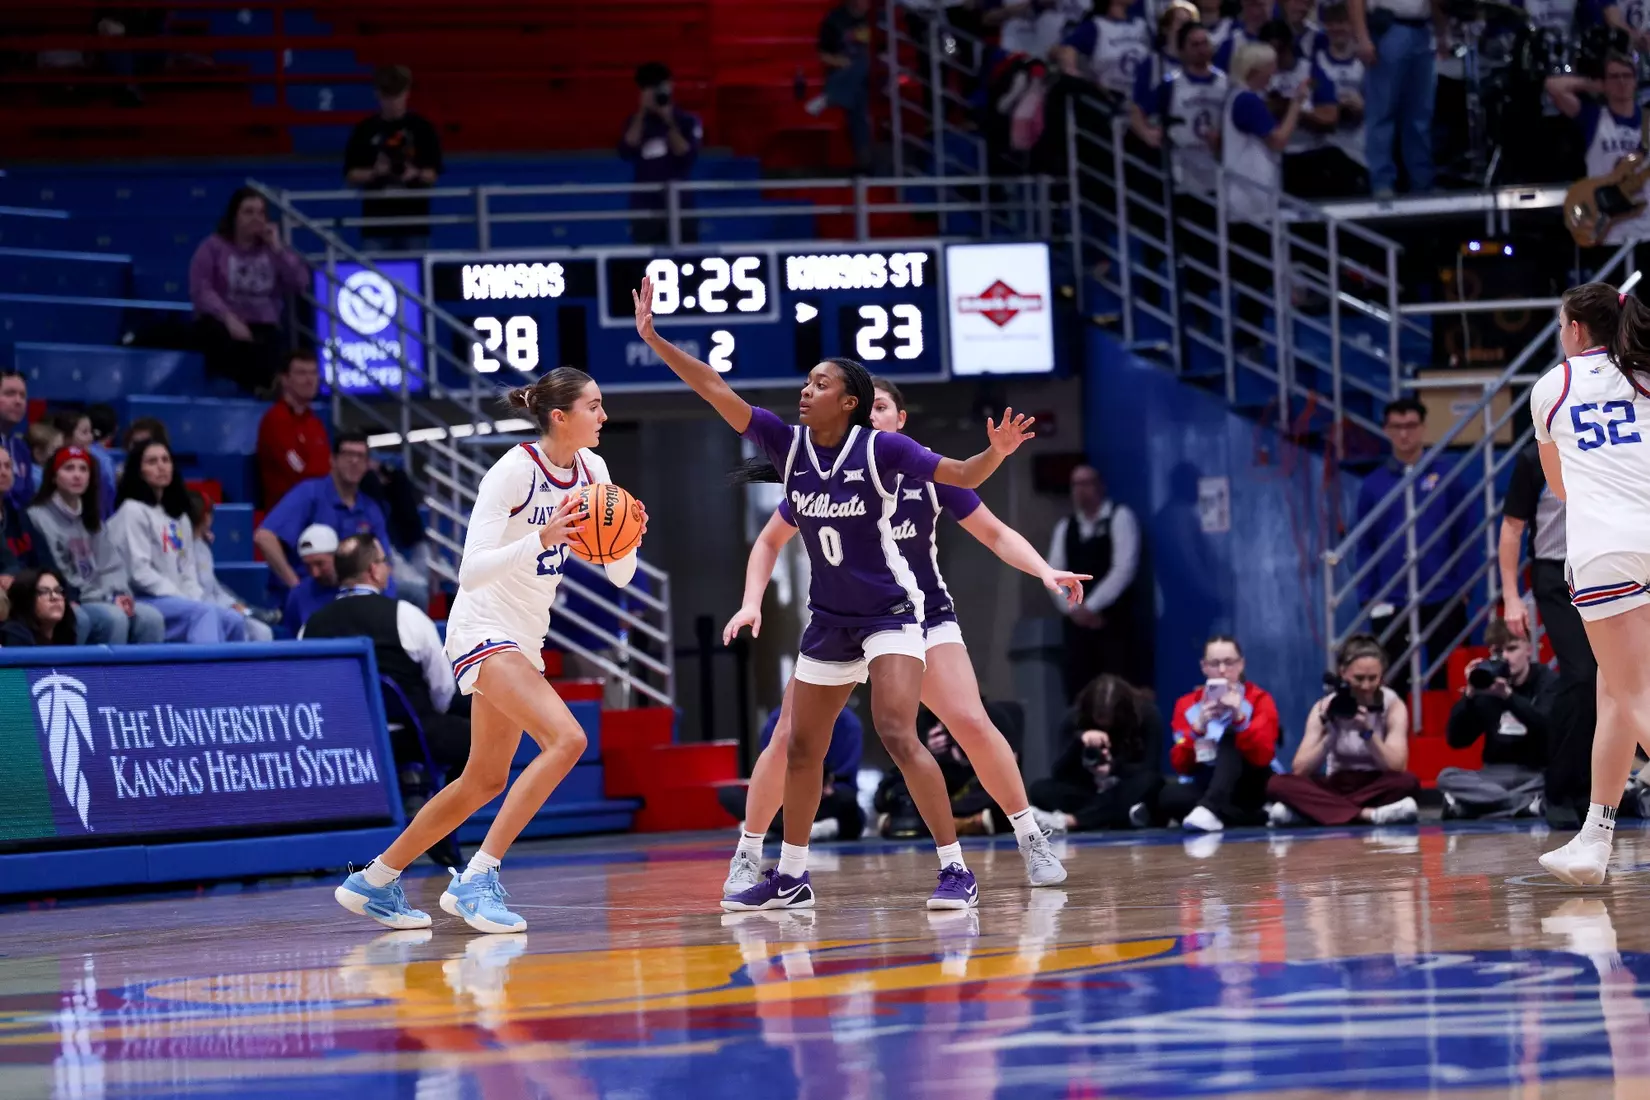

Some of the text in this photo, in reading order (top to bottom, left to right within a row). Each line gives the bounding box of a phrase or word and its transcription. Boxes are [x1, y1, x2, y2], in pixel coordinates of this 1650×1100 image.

[462, 262, 566, 300] KANSAS
[645, 255, 767, 314] 8:25
[786, 252, 928, 290] KANSAS ST
[472, 315, 539, 373] 28
[708, 330, 735, 373] 2
[855, 303, 924, 361] 23
[1570, 401, 1642, 451] 52
[603, 484, 620, 527] Wilson
[791, 490, 867, 518] Wildcats
[817, 525, 844, 567] 0
[293, 702, 325, 741] OF
